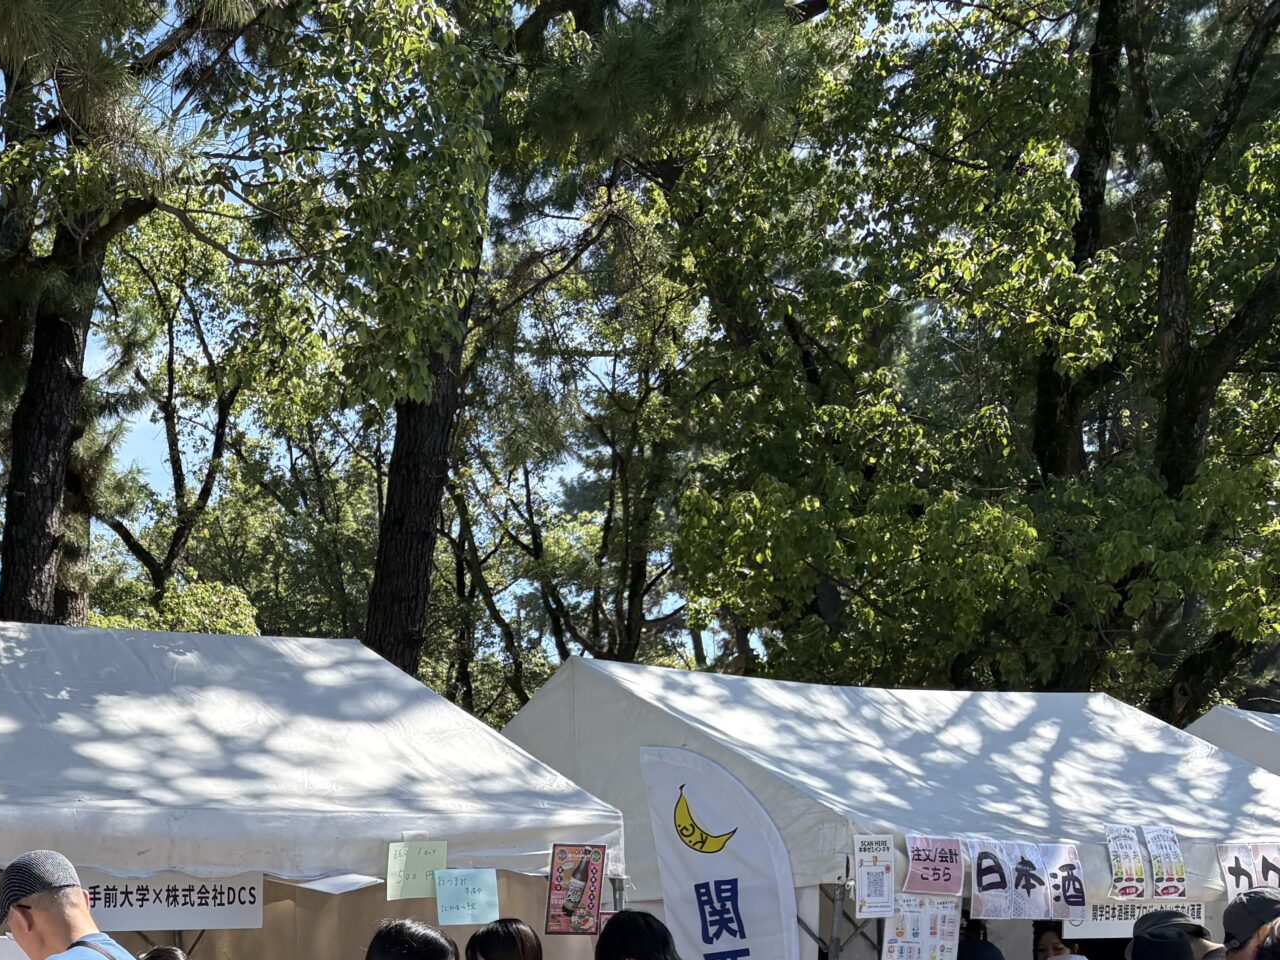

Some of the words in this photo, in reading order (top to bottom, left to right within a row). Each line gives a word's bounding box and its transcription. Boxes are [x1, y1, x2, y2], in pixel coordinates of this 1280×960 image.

[911, 846, 959, 864] 注文/会計
[920, 866, 952, 882] こちら
[976, 851, 1086, 907] 日本酒
